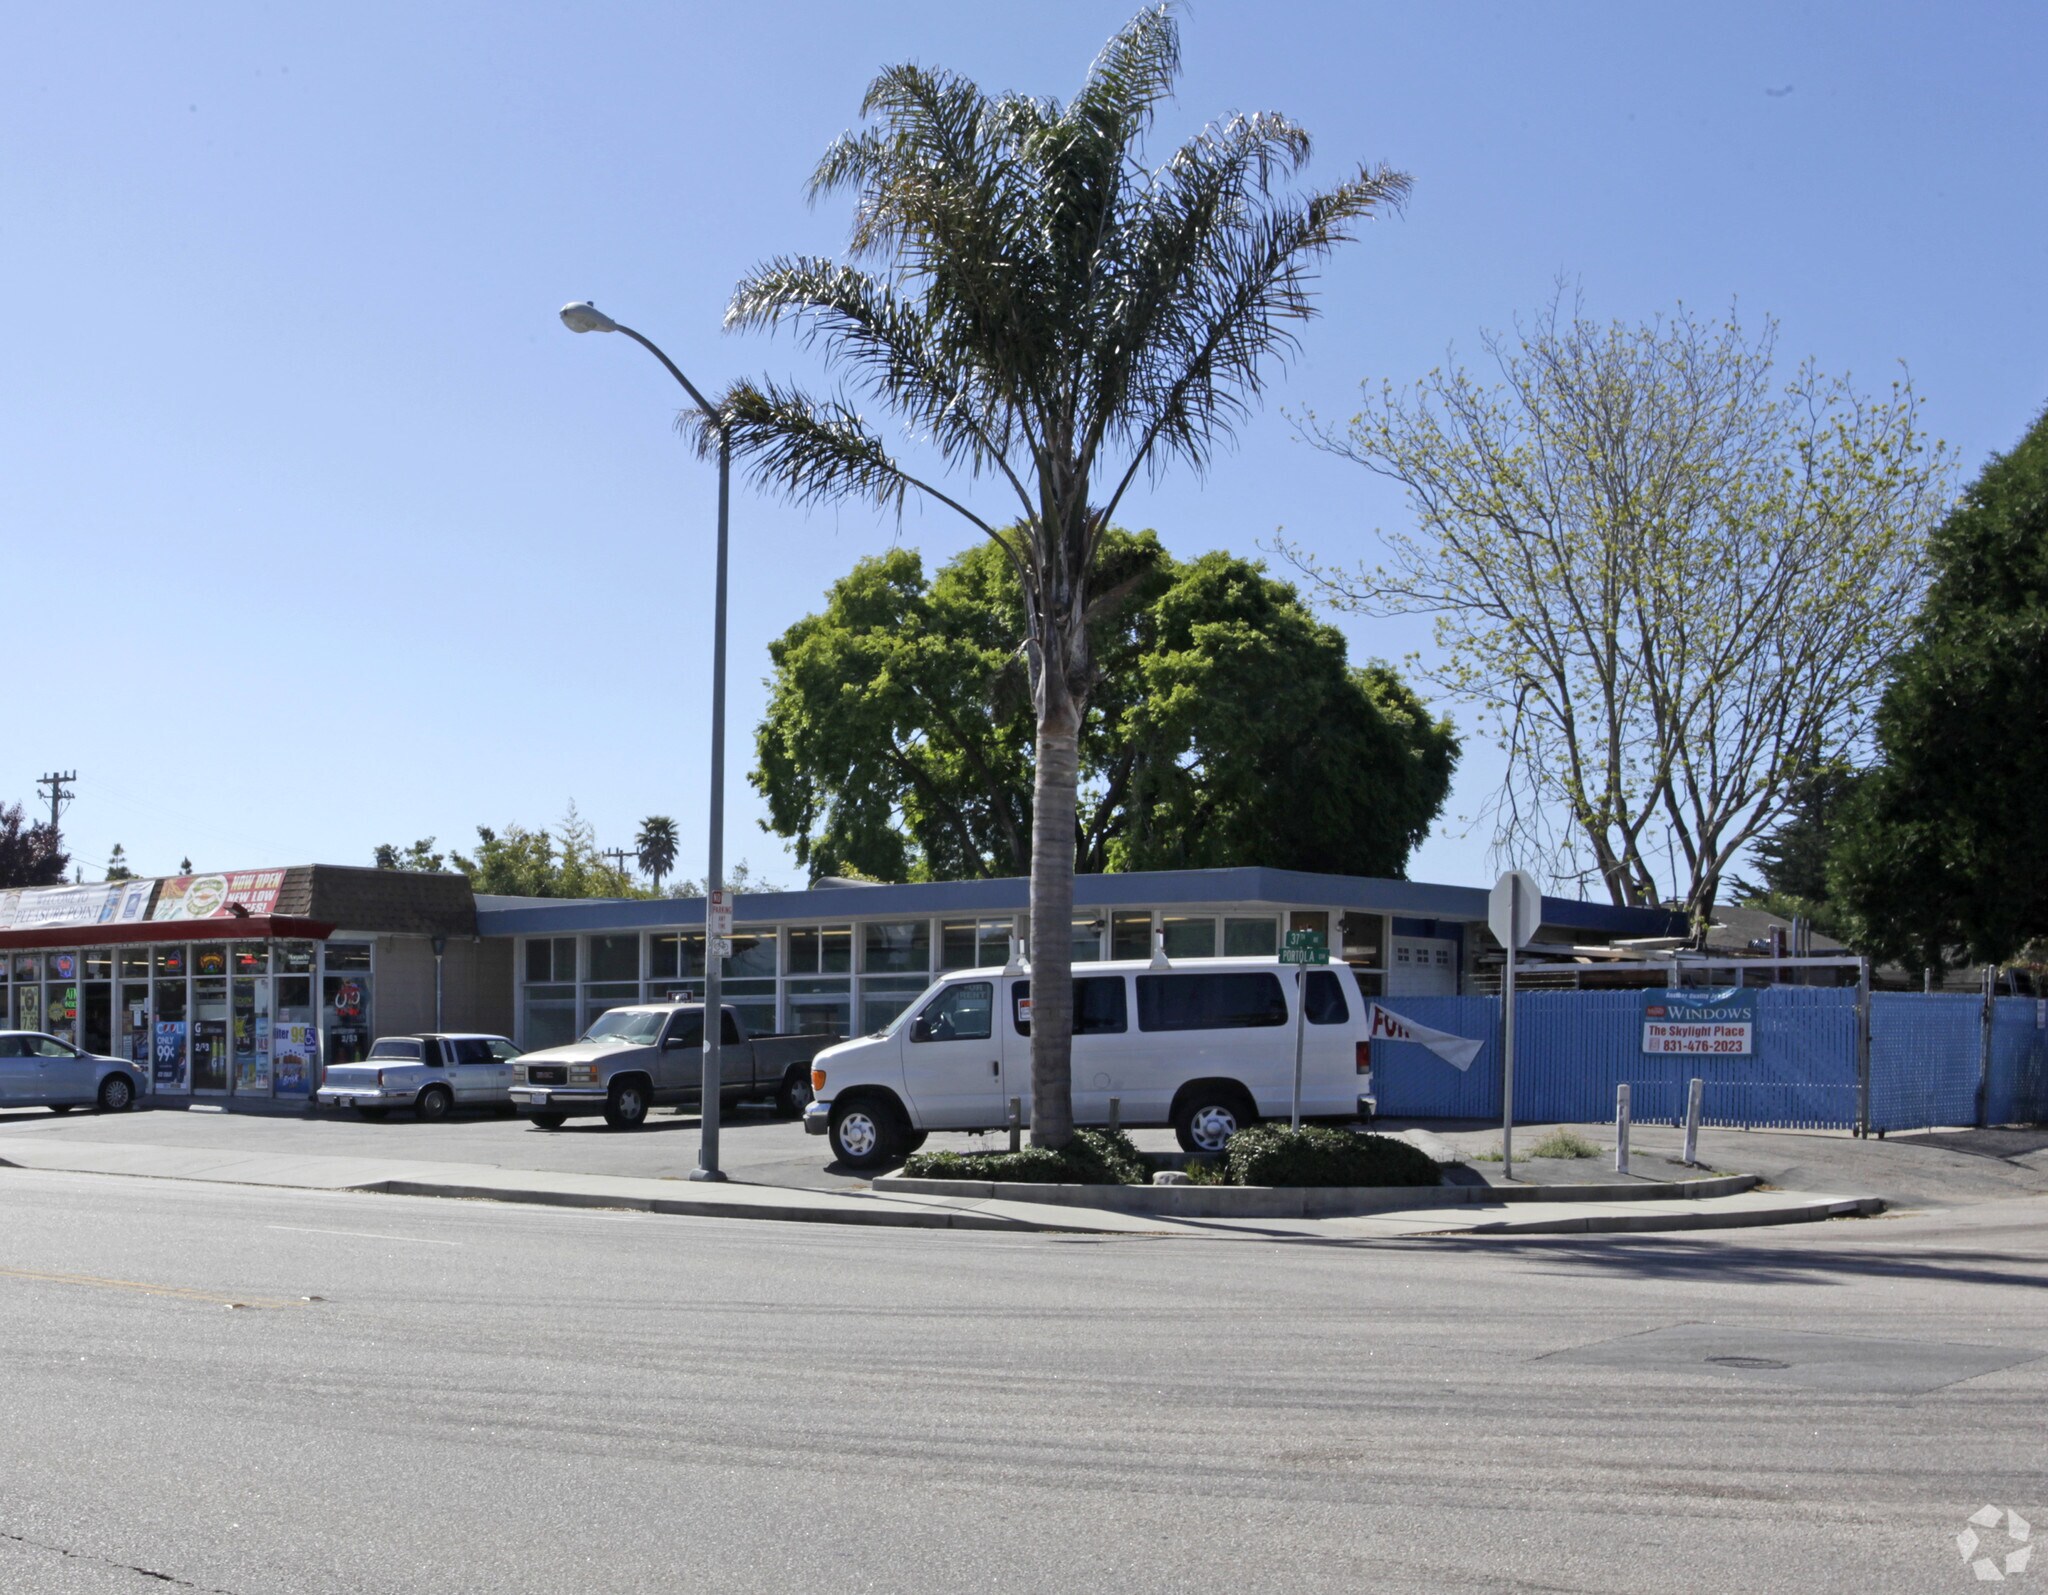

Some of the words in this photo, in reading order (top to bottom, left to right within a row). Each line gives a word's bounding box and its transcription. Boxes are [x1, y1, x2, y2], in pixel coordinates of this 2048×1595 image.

[230, 875, 255, 890] NOW
[255, 872, 283, 889] OPEN
[37, 895, 79, 905] WELCOME
[226, 892, 250, 902] NEW
[251, 890, 276, 902] LOW
[15, 908, 66, 923] PLEASURE
[66, 904, 102, 920] POINT
[1282, 950, 1314, 962] PORTOLA
[1667, 1006, 1752, 1020] WINDOWS
[1649, 1025, 1667, 1036] The
[1669, 1026, 1712, 1038] Skylight
[1714, 1026, 1745, 1036] Place
[157, 1036, 174, 1045] ONLY
[1663, 1040, 1743, 1052] 831-476-2023
